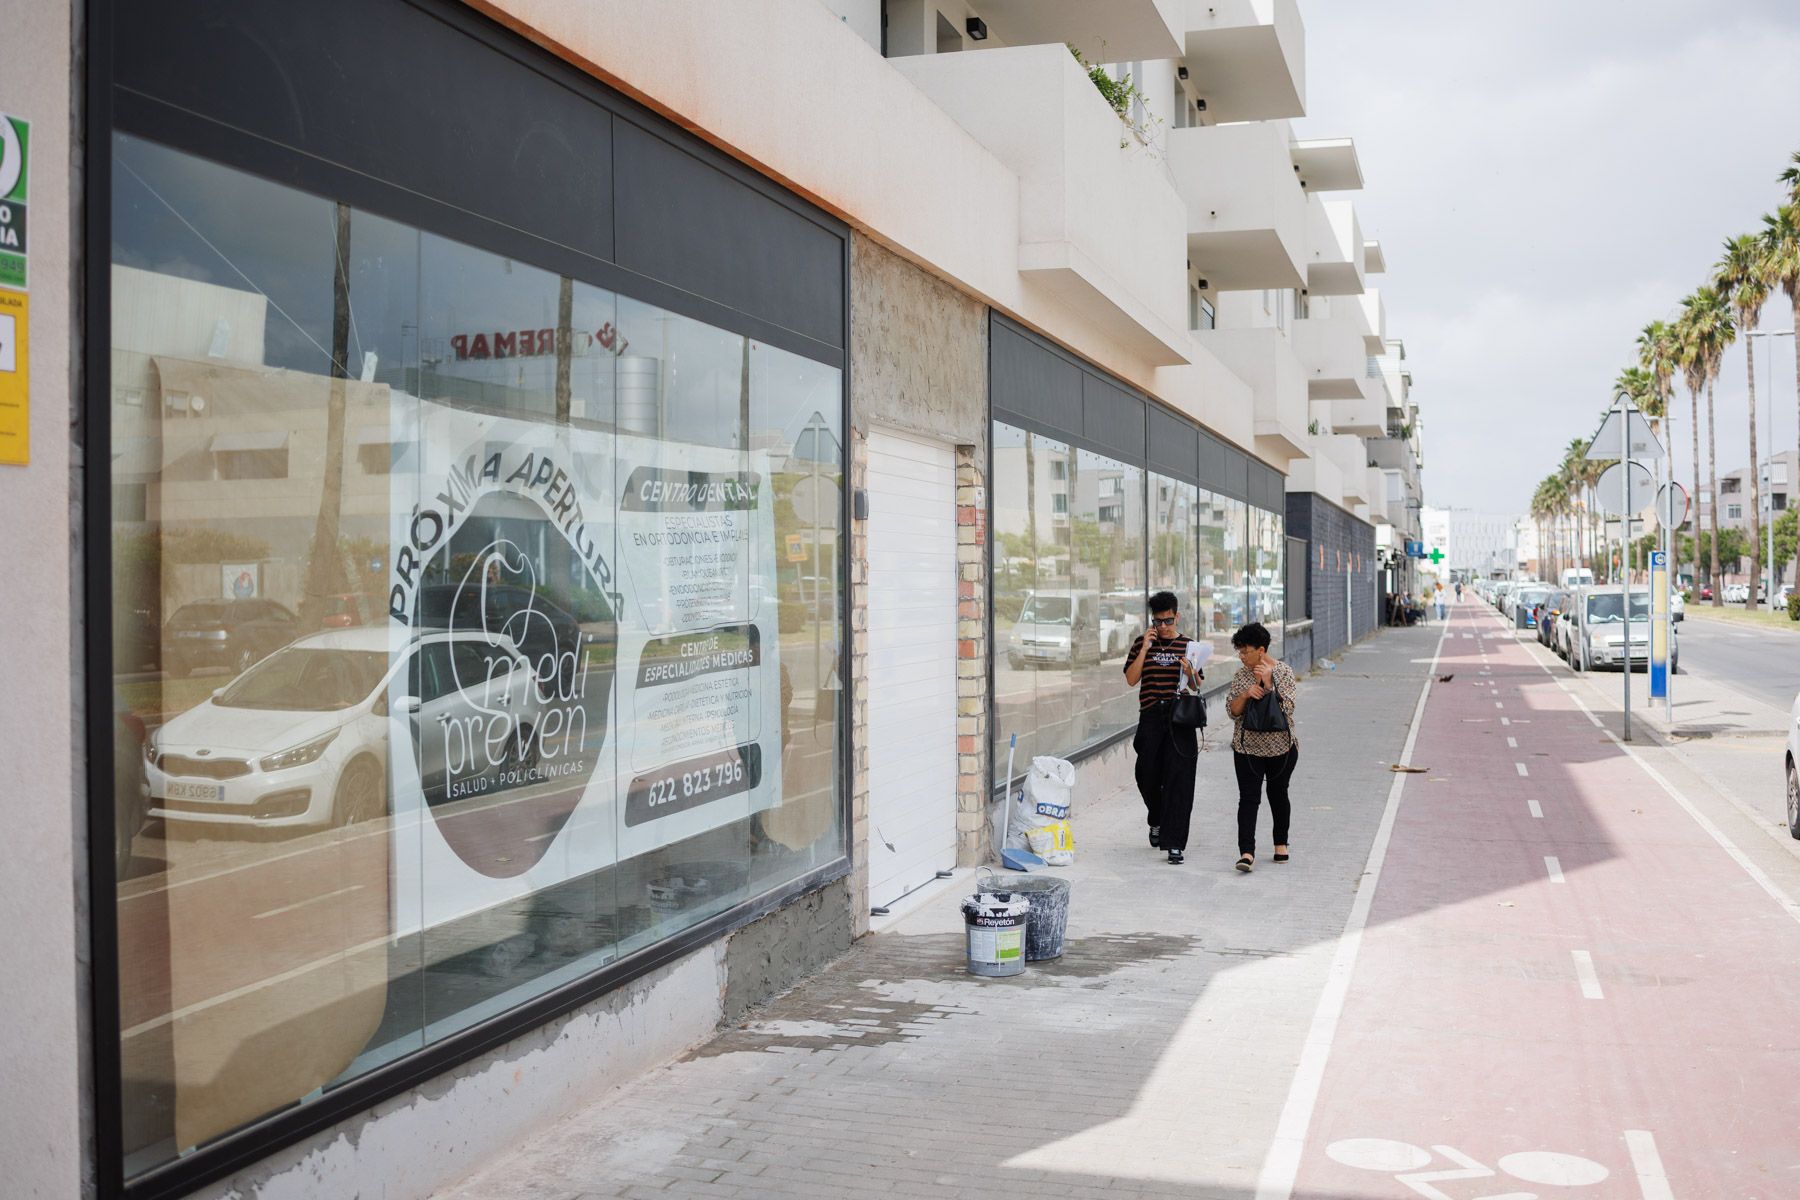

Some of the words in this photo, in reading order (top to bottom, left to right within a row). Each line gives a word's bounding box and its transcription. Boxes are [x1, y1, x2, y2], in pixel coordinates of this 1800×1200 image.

[640, 480, 698, 502] CENTRO
[698, 481, 758, 502] DENTAL
[389, 452, 502, 626] PRÓXIMA
[505, 452, 625, 622] APERTURA
[633, 532, 648, 546] EN
[712, 649, 754, 668] MÉDICAS
[441, 705, 587, 799] preven
[452, 777, 488, 798] SALUD
[648, 777, 677, 807] 622
[682, 767, 711, 797] 823
[715, 759, 743, 787] 796
